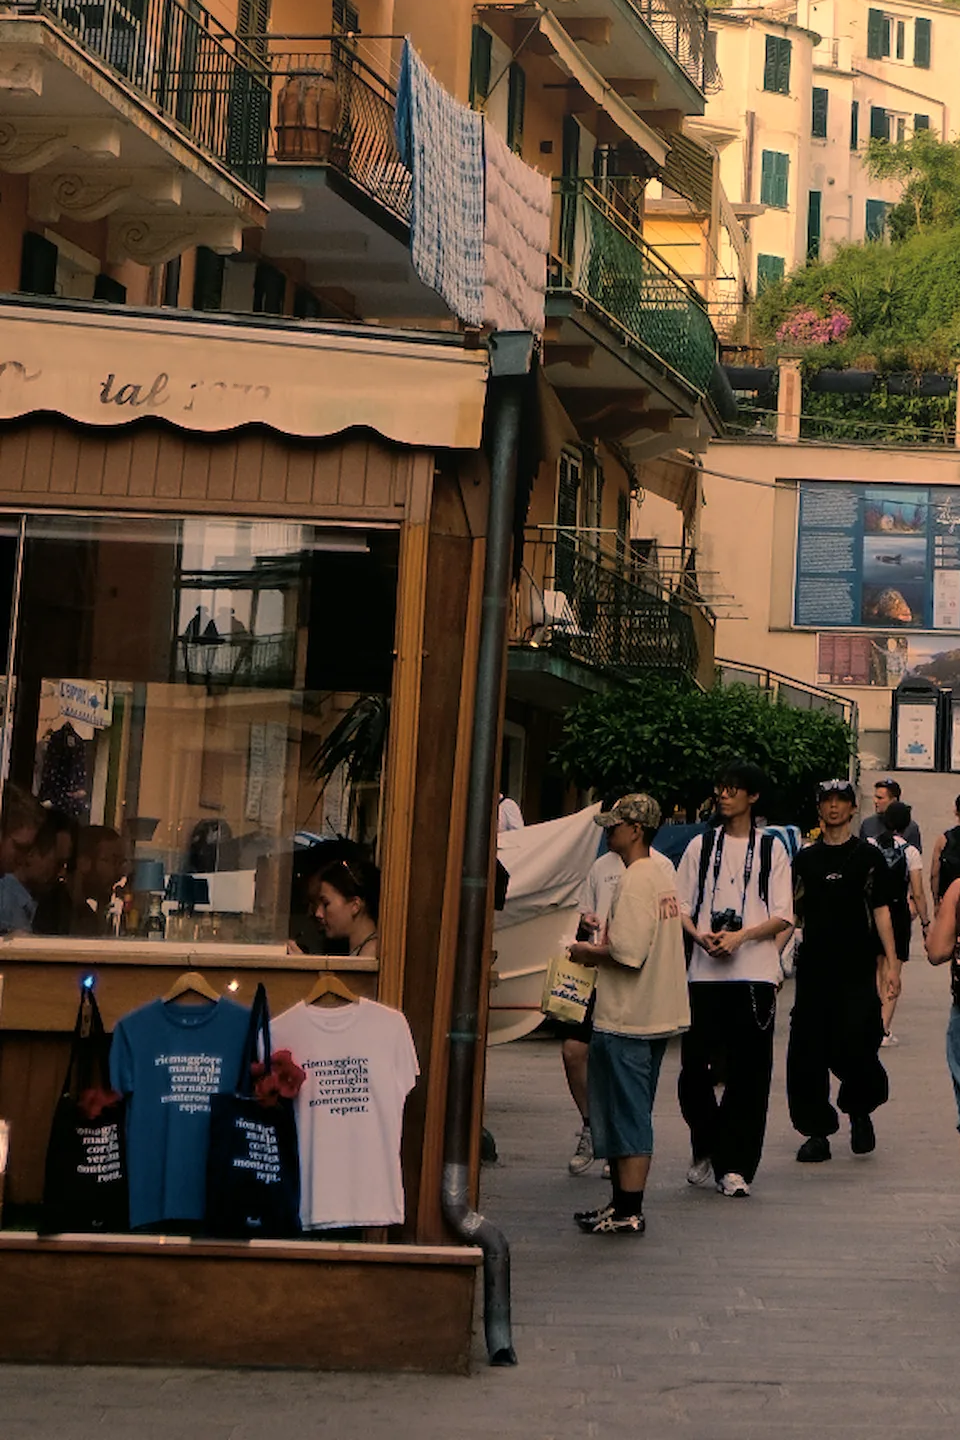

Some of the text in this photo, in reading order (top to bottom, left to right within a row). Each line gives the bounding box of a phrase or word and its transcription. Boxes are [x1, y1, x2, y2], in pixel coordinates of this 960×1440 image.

[168, 1063, 221, 1074] manarola
[301, 1056, 369, 1070] riomaggiore
[315, 1065, 368, 1077] manarola
[170, 1072, 221, 1085] corniglia
[318, 1074, 368, 1086] corniglia
[170, 1084, 220, 1093] vernazza
[319, 1086, 369, 1096] vernazza
[309, 1097, 369, 1108] monterosso
